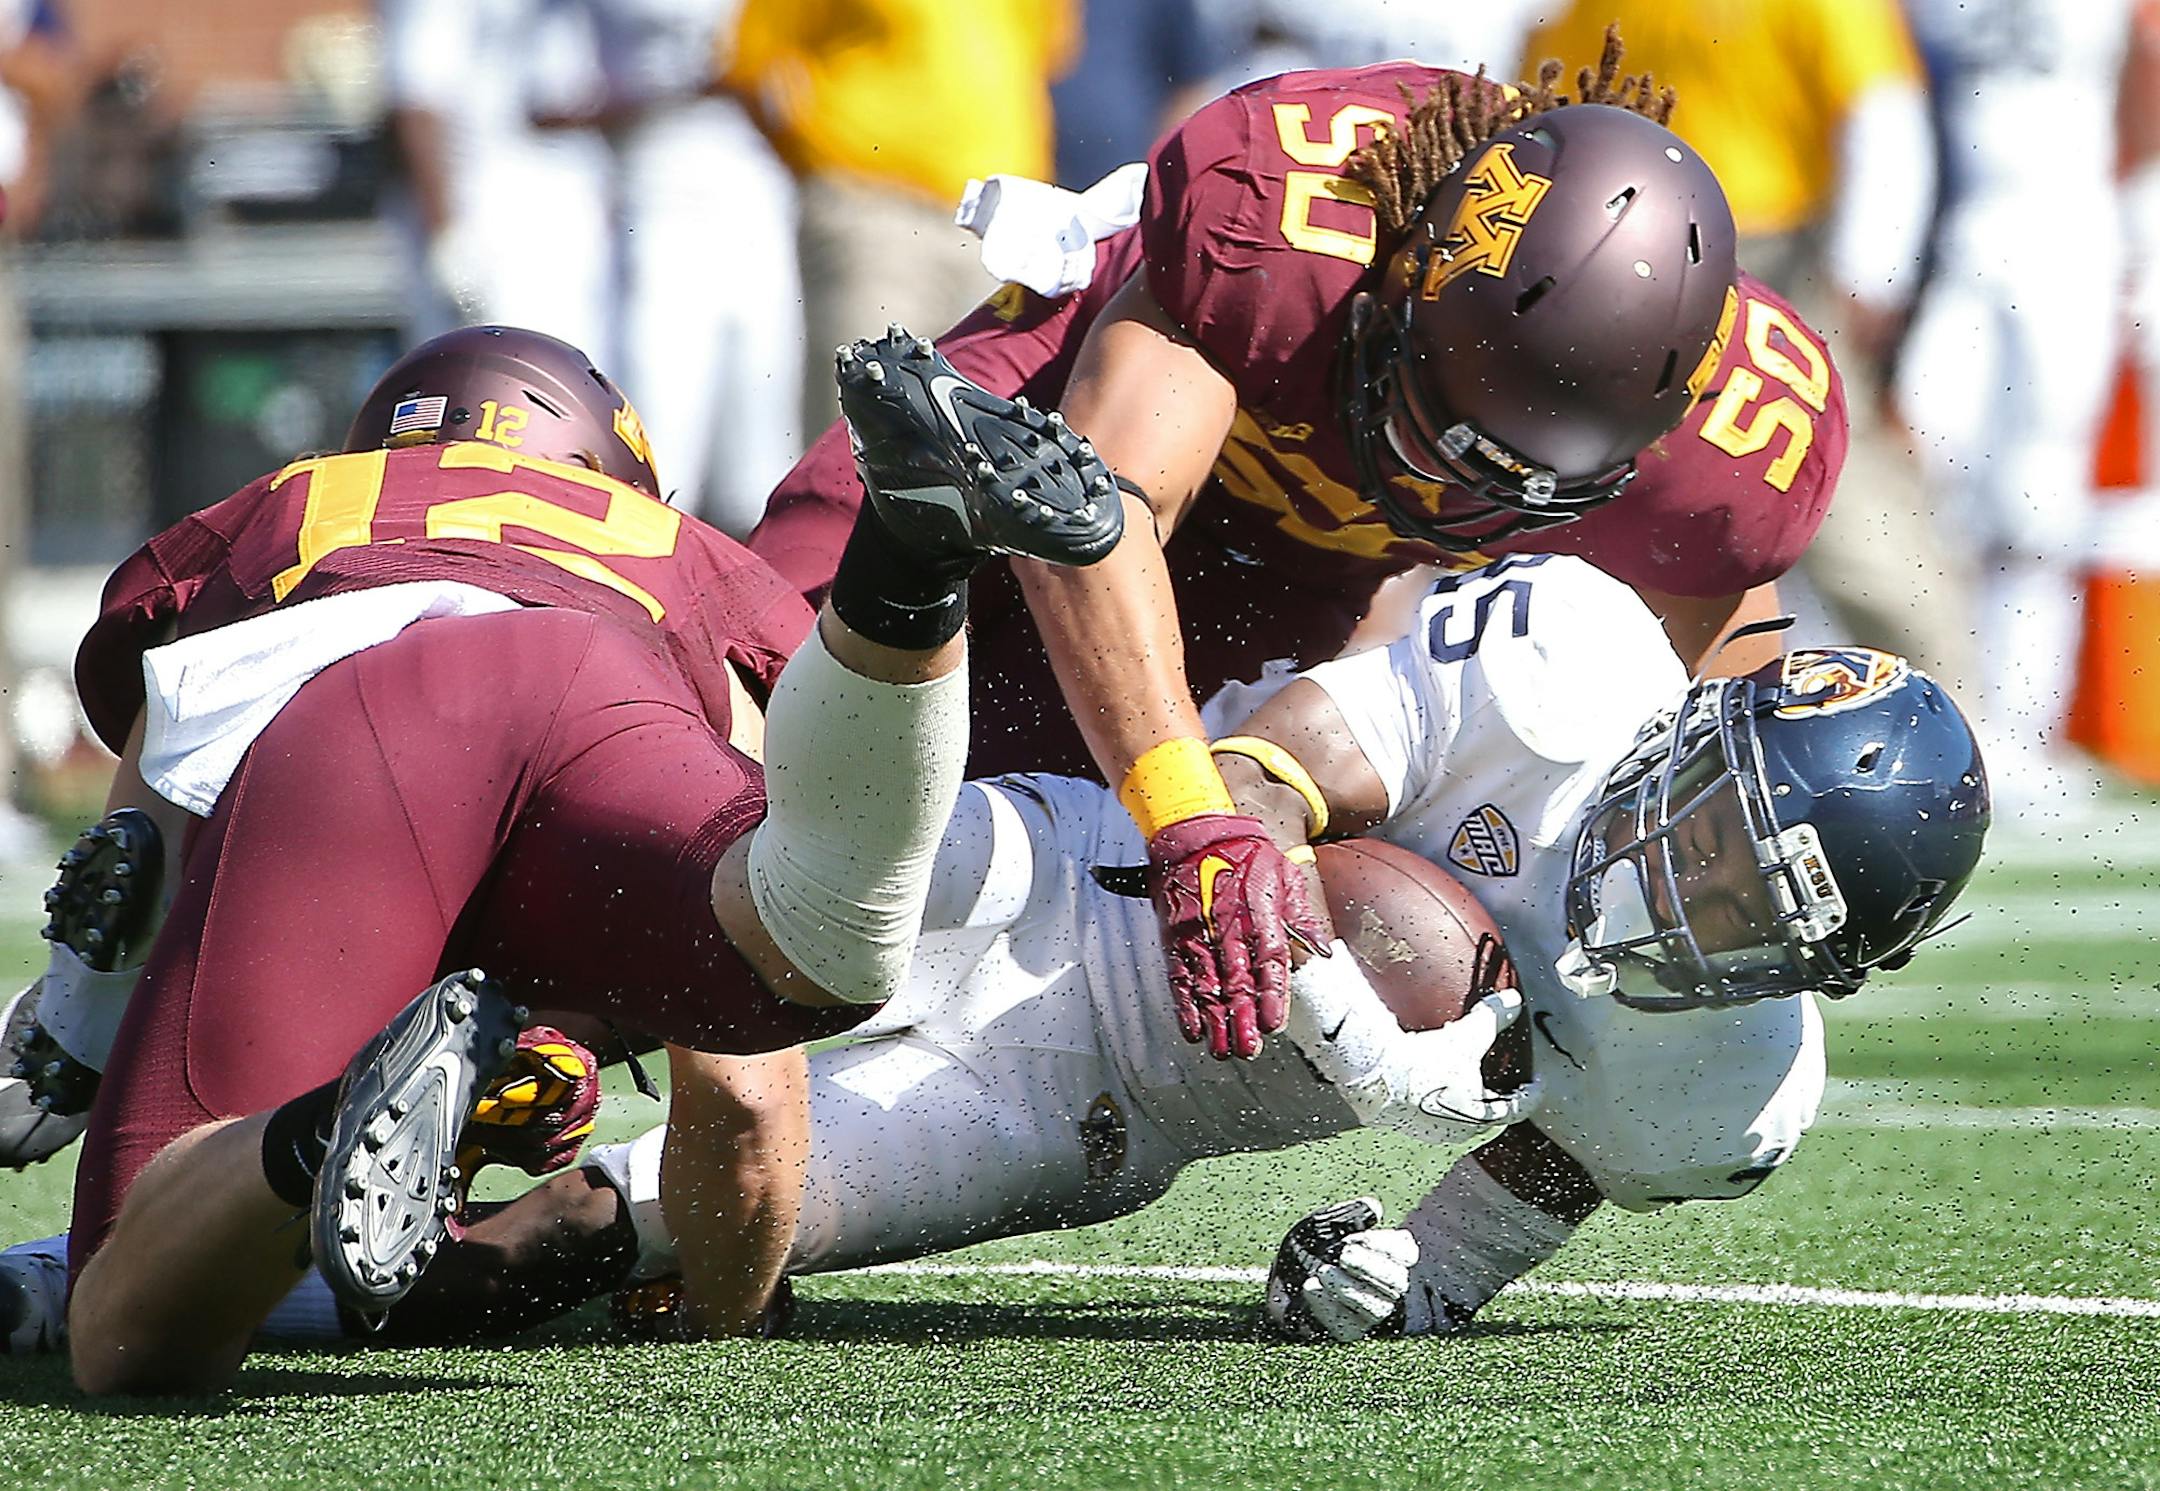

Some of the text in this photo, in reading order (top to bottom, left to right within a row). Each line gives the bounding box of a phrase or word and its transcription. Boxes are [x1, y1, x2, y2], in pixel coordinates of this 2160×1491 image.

[1271, 102, 1397, 266] 50
[474, 400, 530, 448] 12
[1698, 297, 1831, 494] 50
[271, 442, 682, 624] 12
[1465, 814, 1506, 877] MAC
